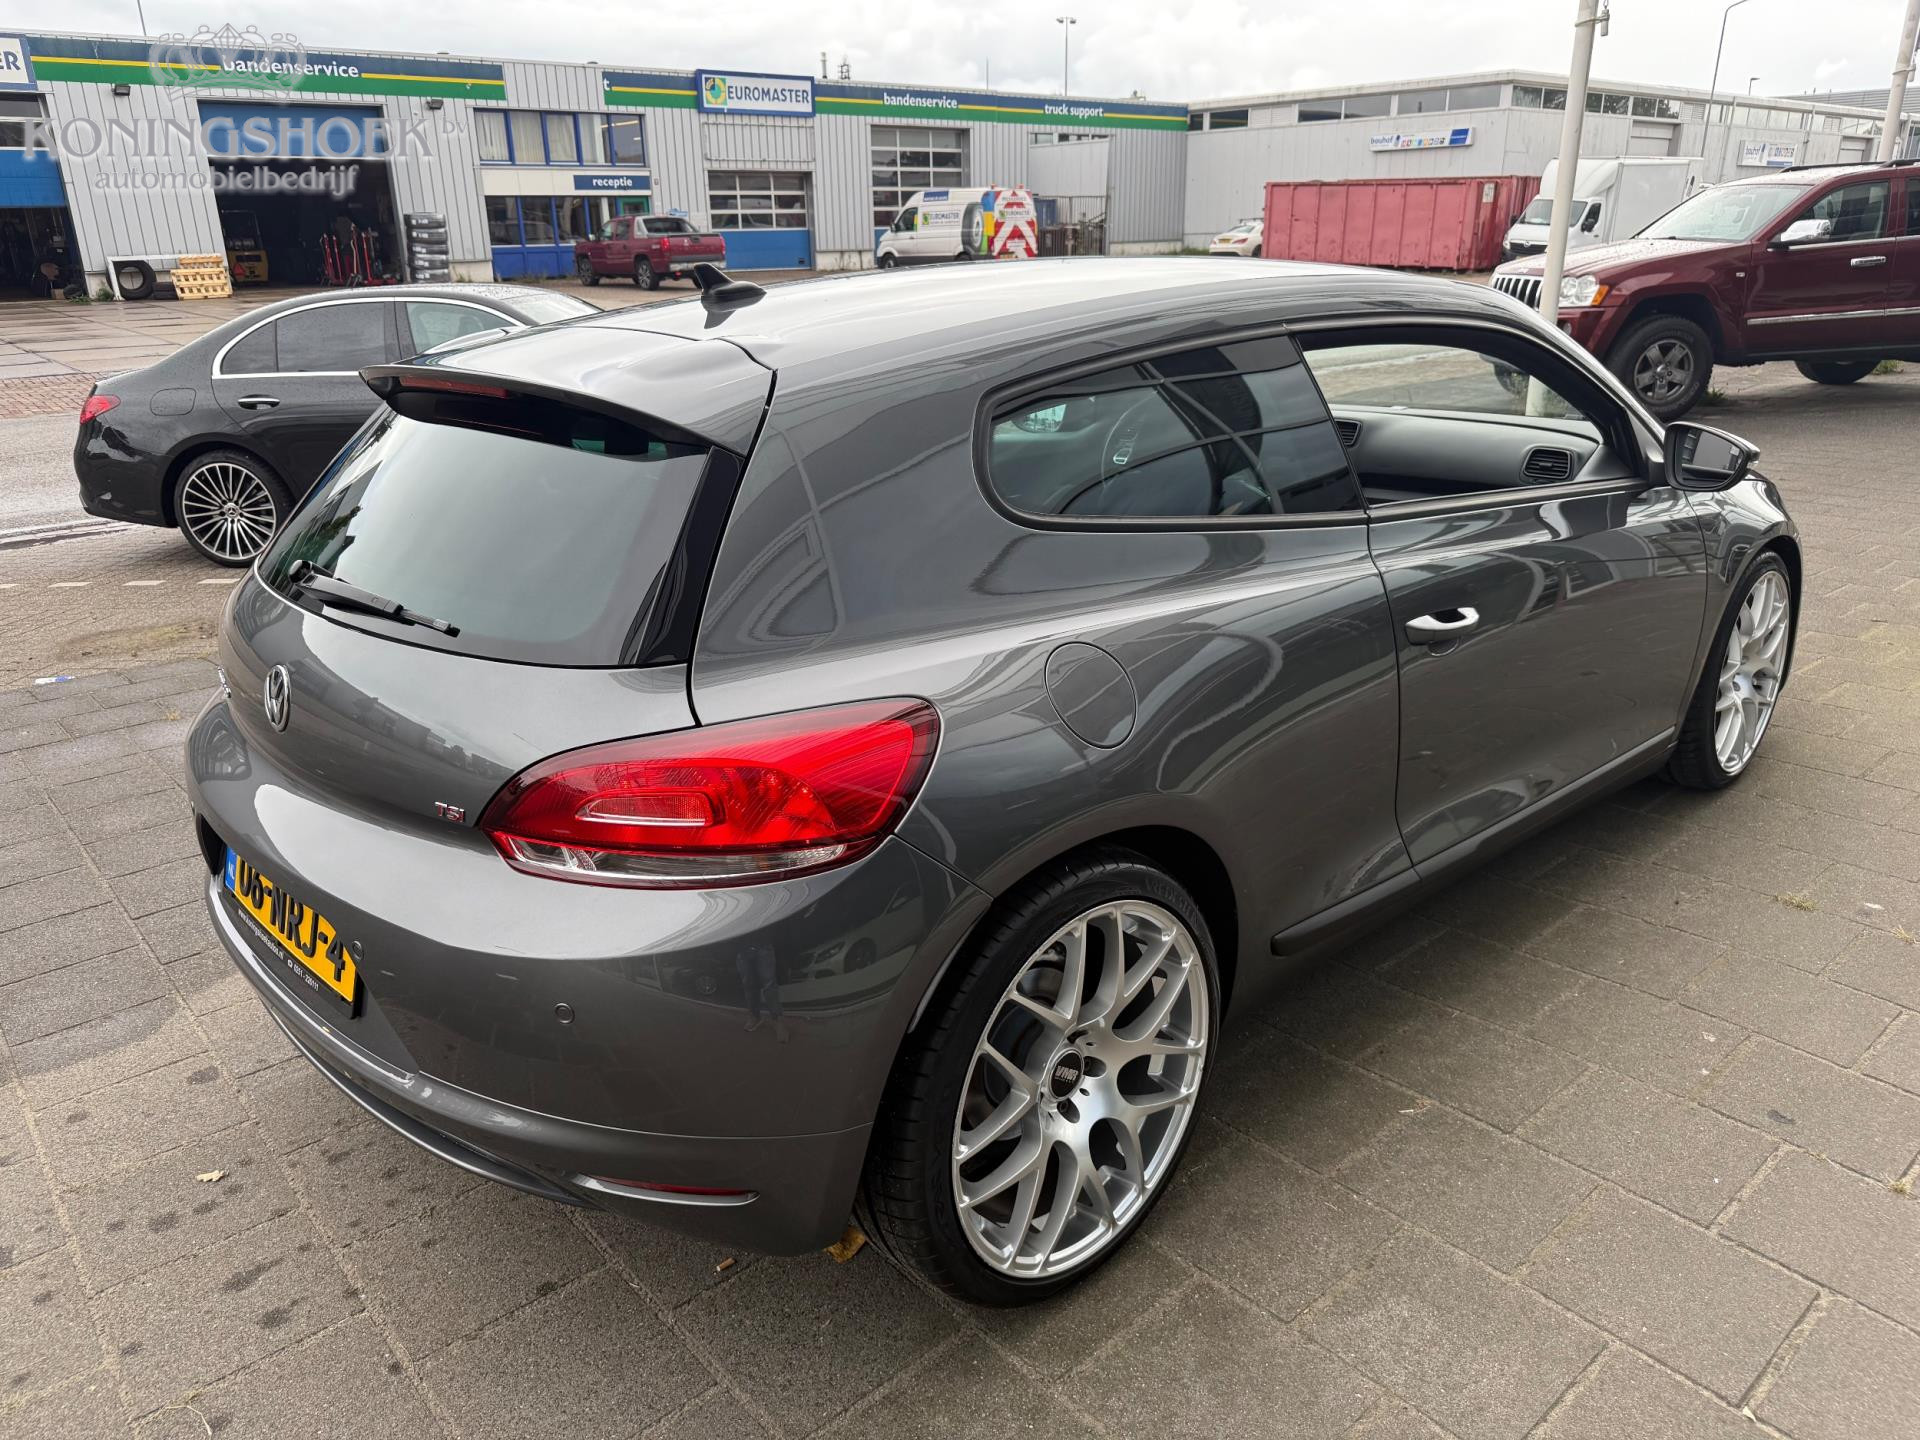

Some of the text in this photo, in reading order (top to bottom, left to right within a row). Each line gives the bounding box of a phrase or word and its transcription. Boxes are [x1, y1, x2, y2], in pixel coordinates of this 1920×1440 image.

[222, 55, 359, 78] bandenservice
[727, 85, 810, 104] EUROMASTER
[883, 92, 958, 109] bandenservice
[1045, 104, 1104, 119] truck support
[592, 176, 633, 189] receptie
[434, 801, 465, 823] TSI
